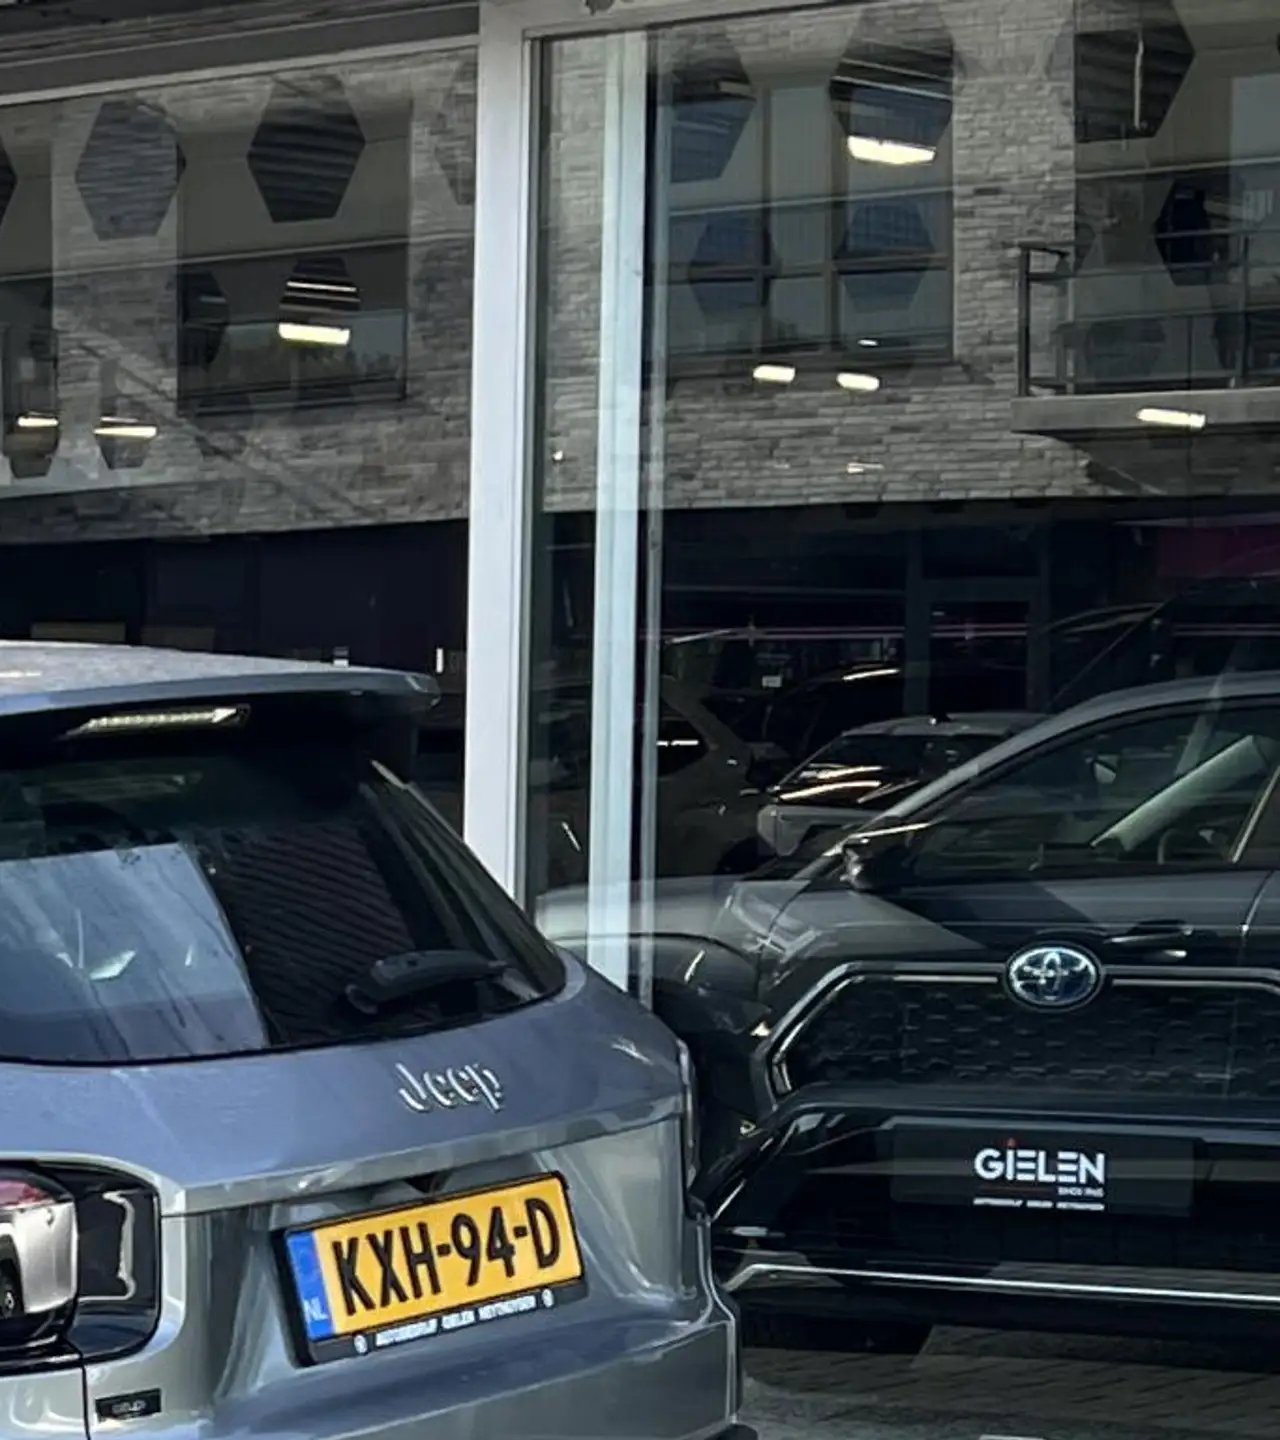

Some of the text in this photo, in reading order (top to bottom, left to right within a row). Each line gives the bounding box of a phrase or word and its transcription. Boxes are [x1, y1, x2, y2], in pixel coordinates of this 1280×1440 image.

[396, 1062, 503, 1113] Jeep
[973, 1143, 1106, 1184] GIELEN
[332, 1198, 562, 1317] KXH-94-D
[304, 1298, 328, 1322] NL
